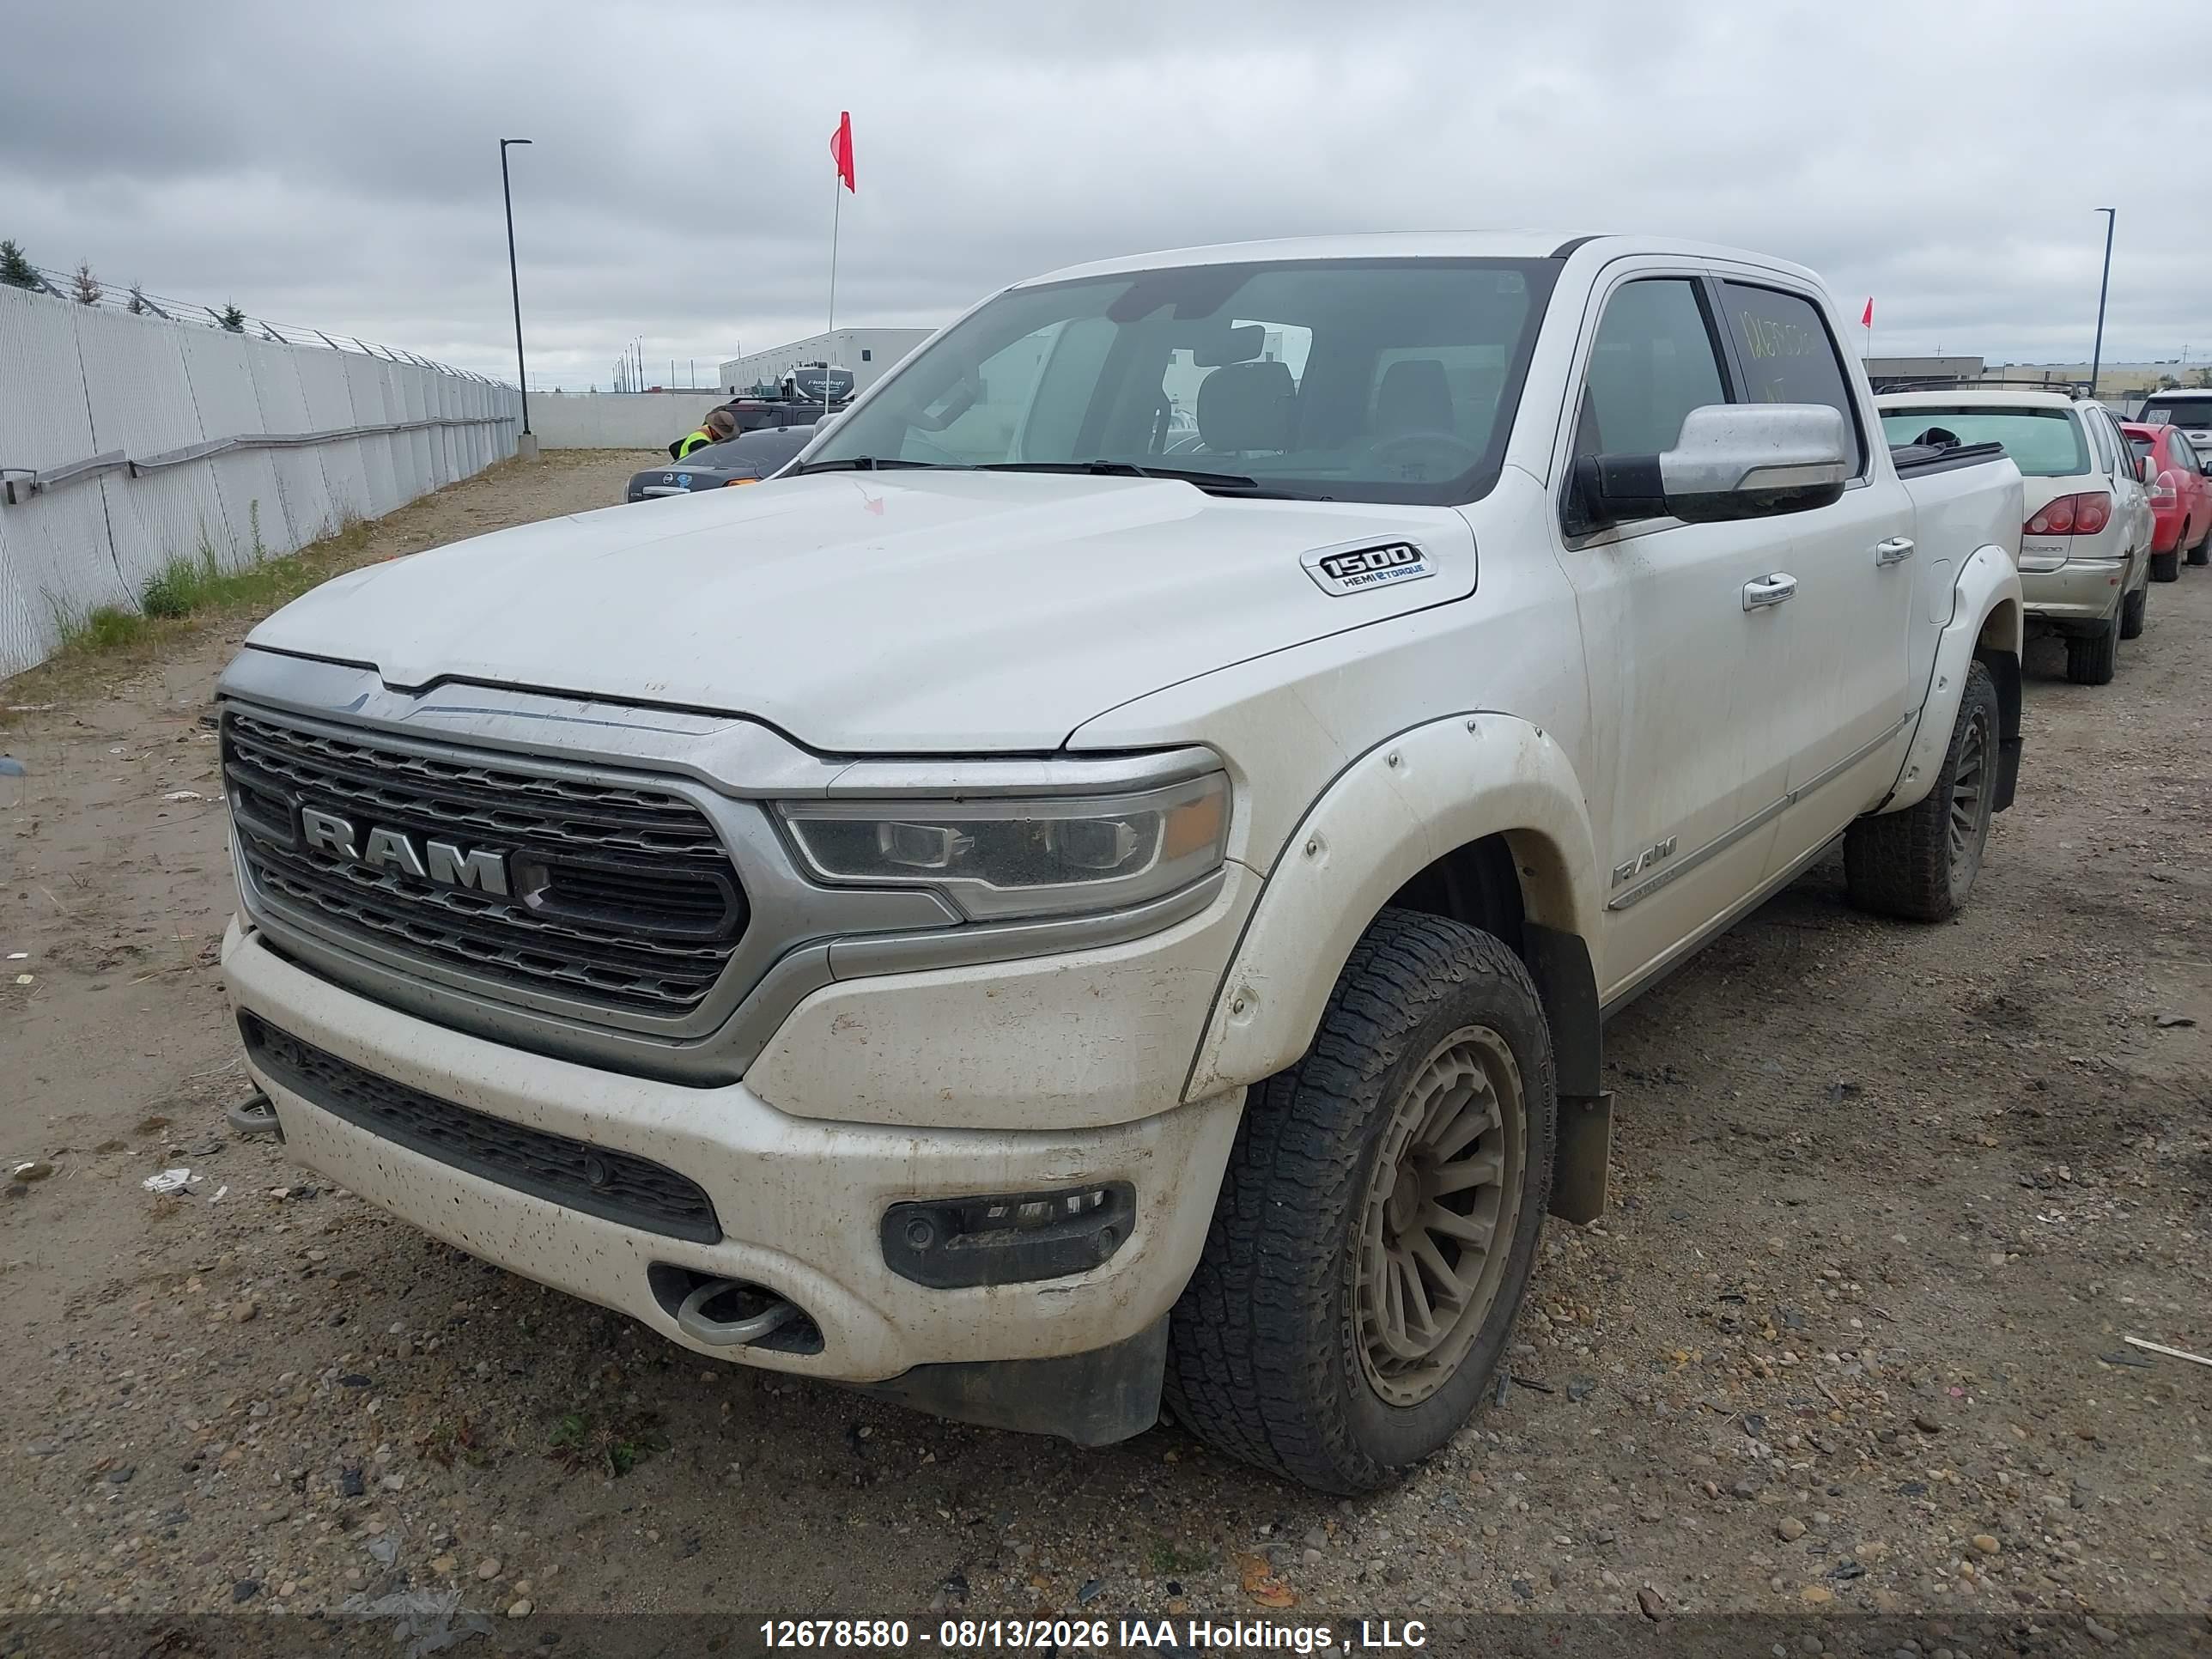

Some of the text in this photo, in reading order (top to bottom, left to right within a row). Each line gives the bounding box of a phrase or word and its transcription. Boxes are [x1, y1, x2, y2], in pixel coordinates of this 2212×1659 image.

[1323, 545, 1414, 577] 1500
[1343, 574, 1376, 587] HEMI
[302, 807, 508, 896] RAM
[1611, 835, 1677, 889] RAM
